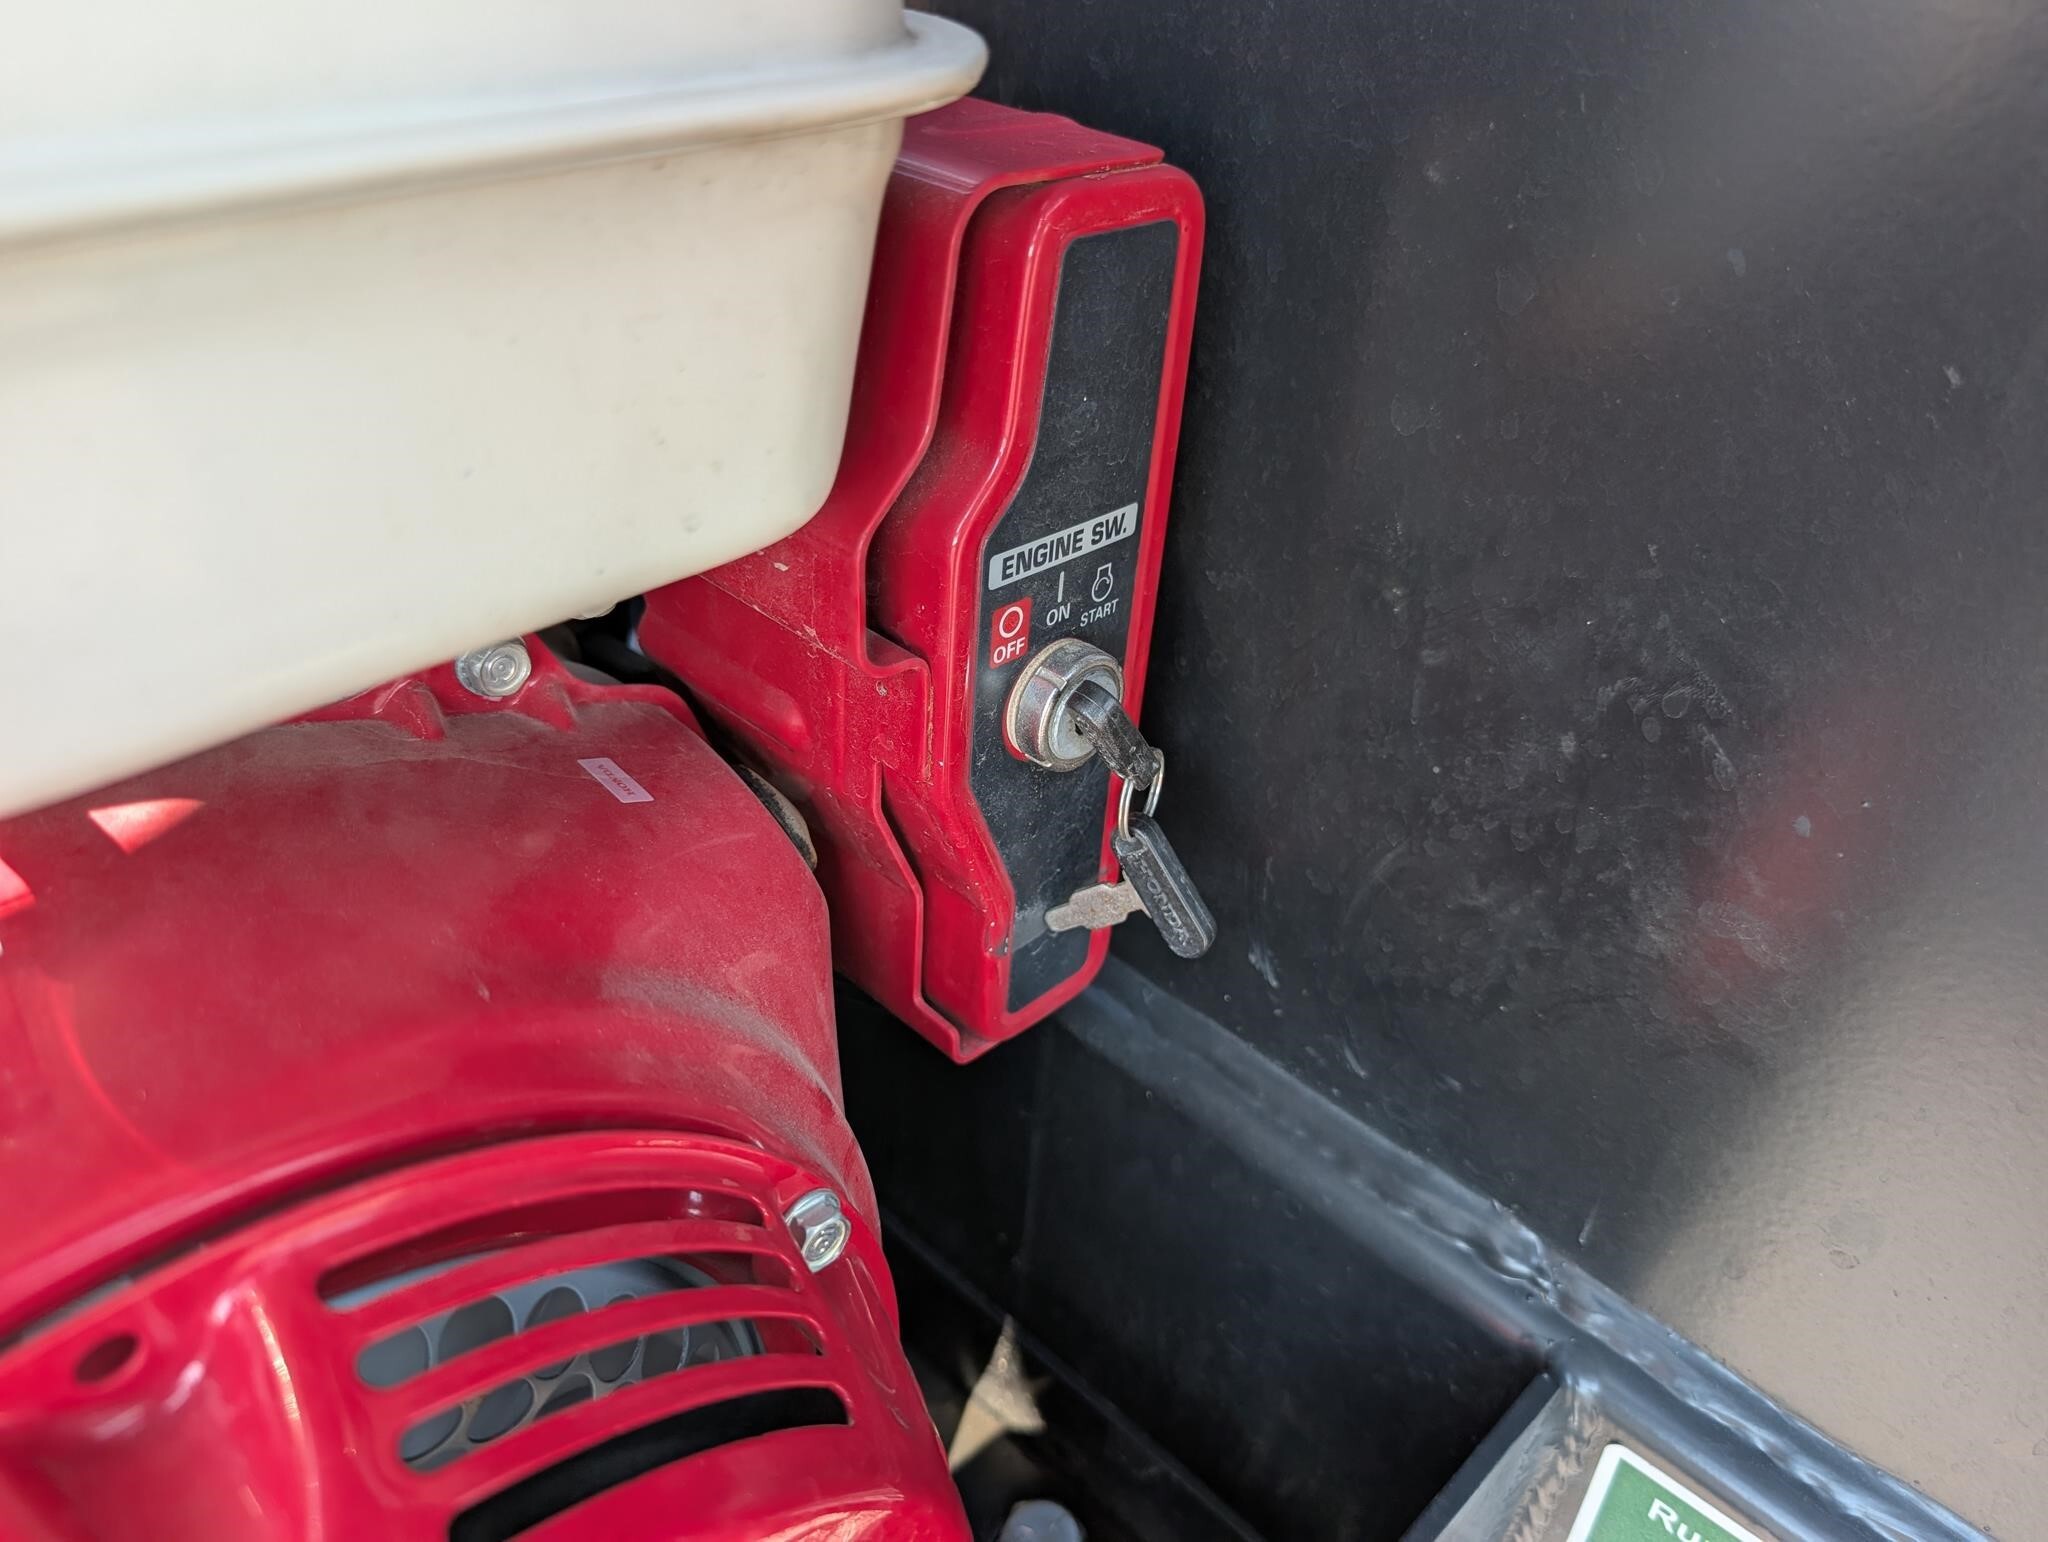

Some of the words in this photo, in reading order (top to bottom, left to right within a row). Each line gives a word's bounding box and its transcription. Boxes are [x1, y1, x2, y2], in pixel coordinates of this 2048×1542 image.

[1001, 528, 1085, 581] ENGINE
[1090, 512, 1127, 546] SW.
[1046, 603, 1071, 626] ON
[1079, 598, 1119, 628] START
[993, 636, 1026, 664] OFF
[1128, 854, 1190, 946] HONDA
[1647, 1497, 1710, 1542] Ru
